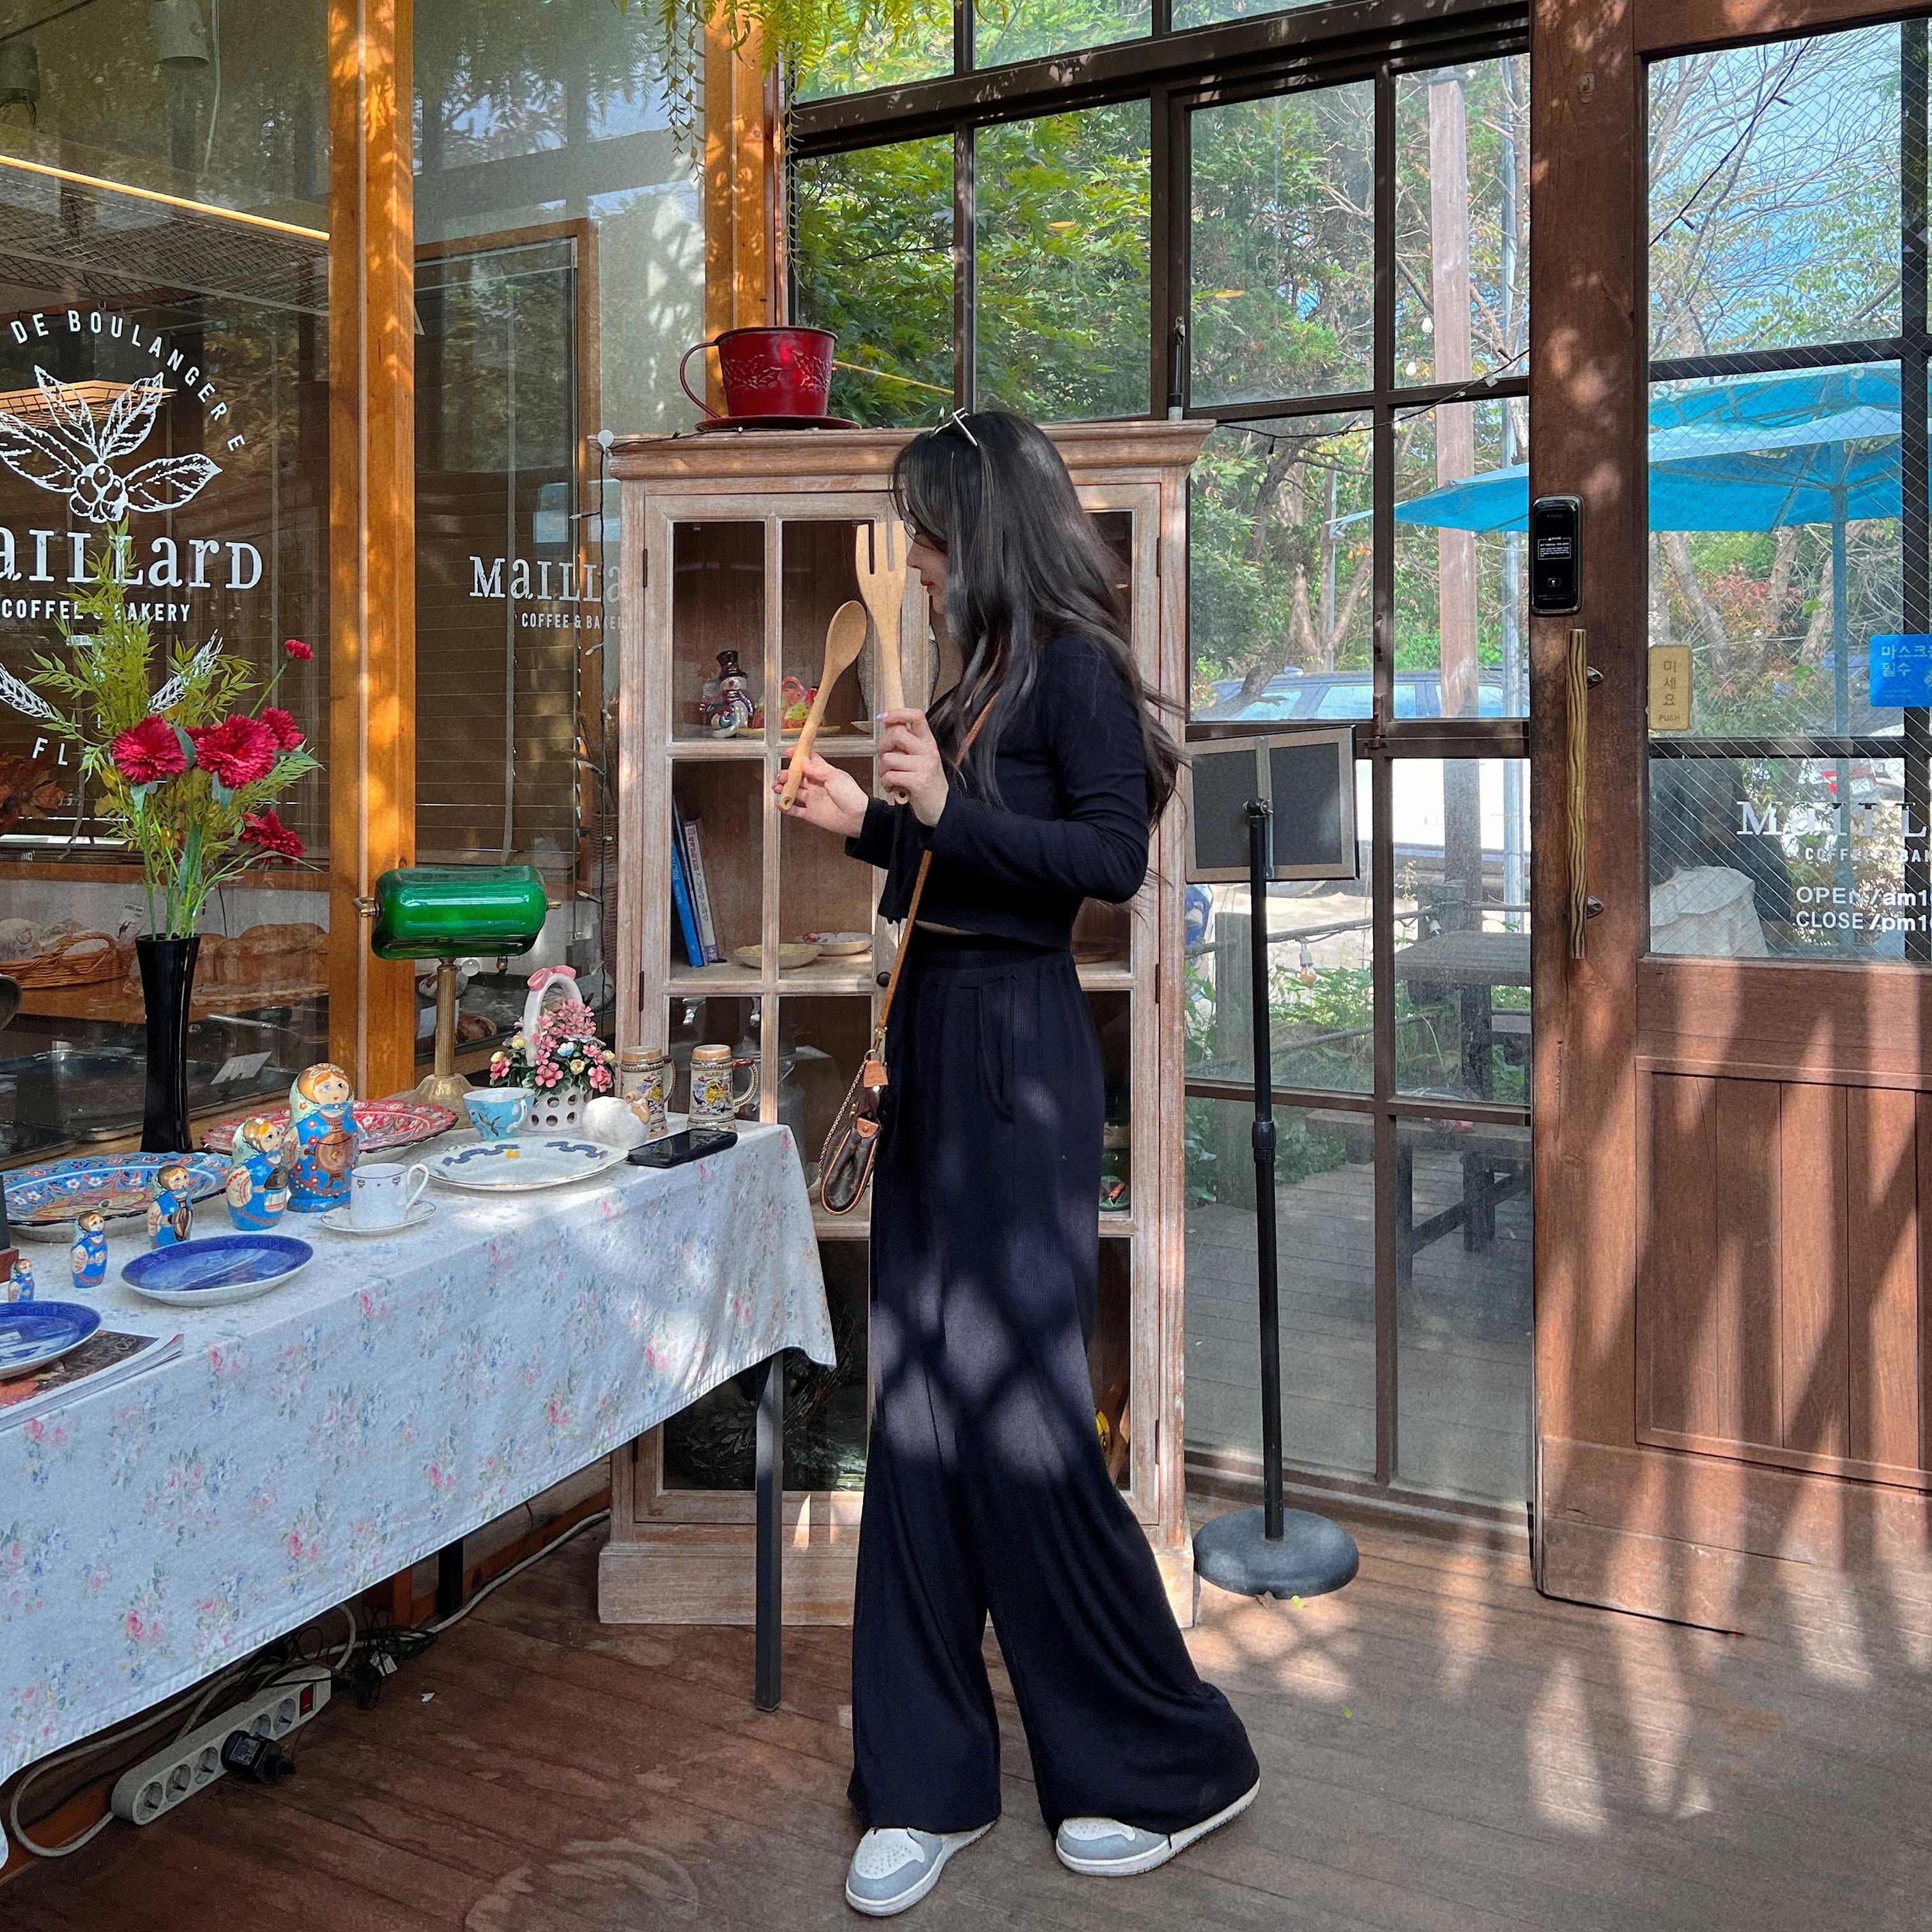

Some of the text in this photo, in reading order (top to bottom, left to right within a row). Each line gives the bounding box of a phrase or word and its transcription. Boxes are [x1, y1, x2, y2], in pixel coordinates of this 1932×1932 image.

[10, 312, 49, 345] DE
[521, 612, 569, 628] COFFEE
[574, 615, 581, 629] &
[1881, 645, 1932, 660] 마스크
[1882, 662, 1912, 677] 필수
[1663, 661, 1676, 706] 미세요
[1796, 886, 1932, 906] OPEN /am1
[1796, 910, 1932, 933] CLOSE /pm1
